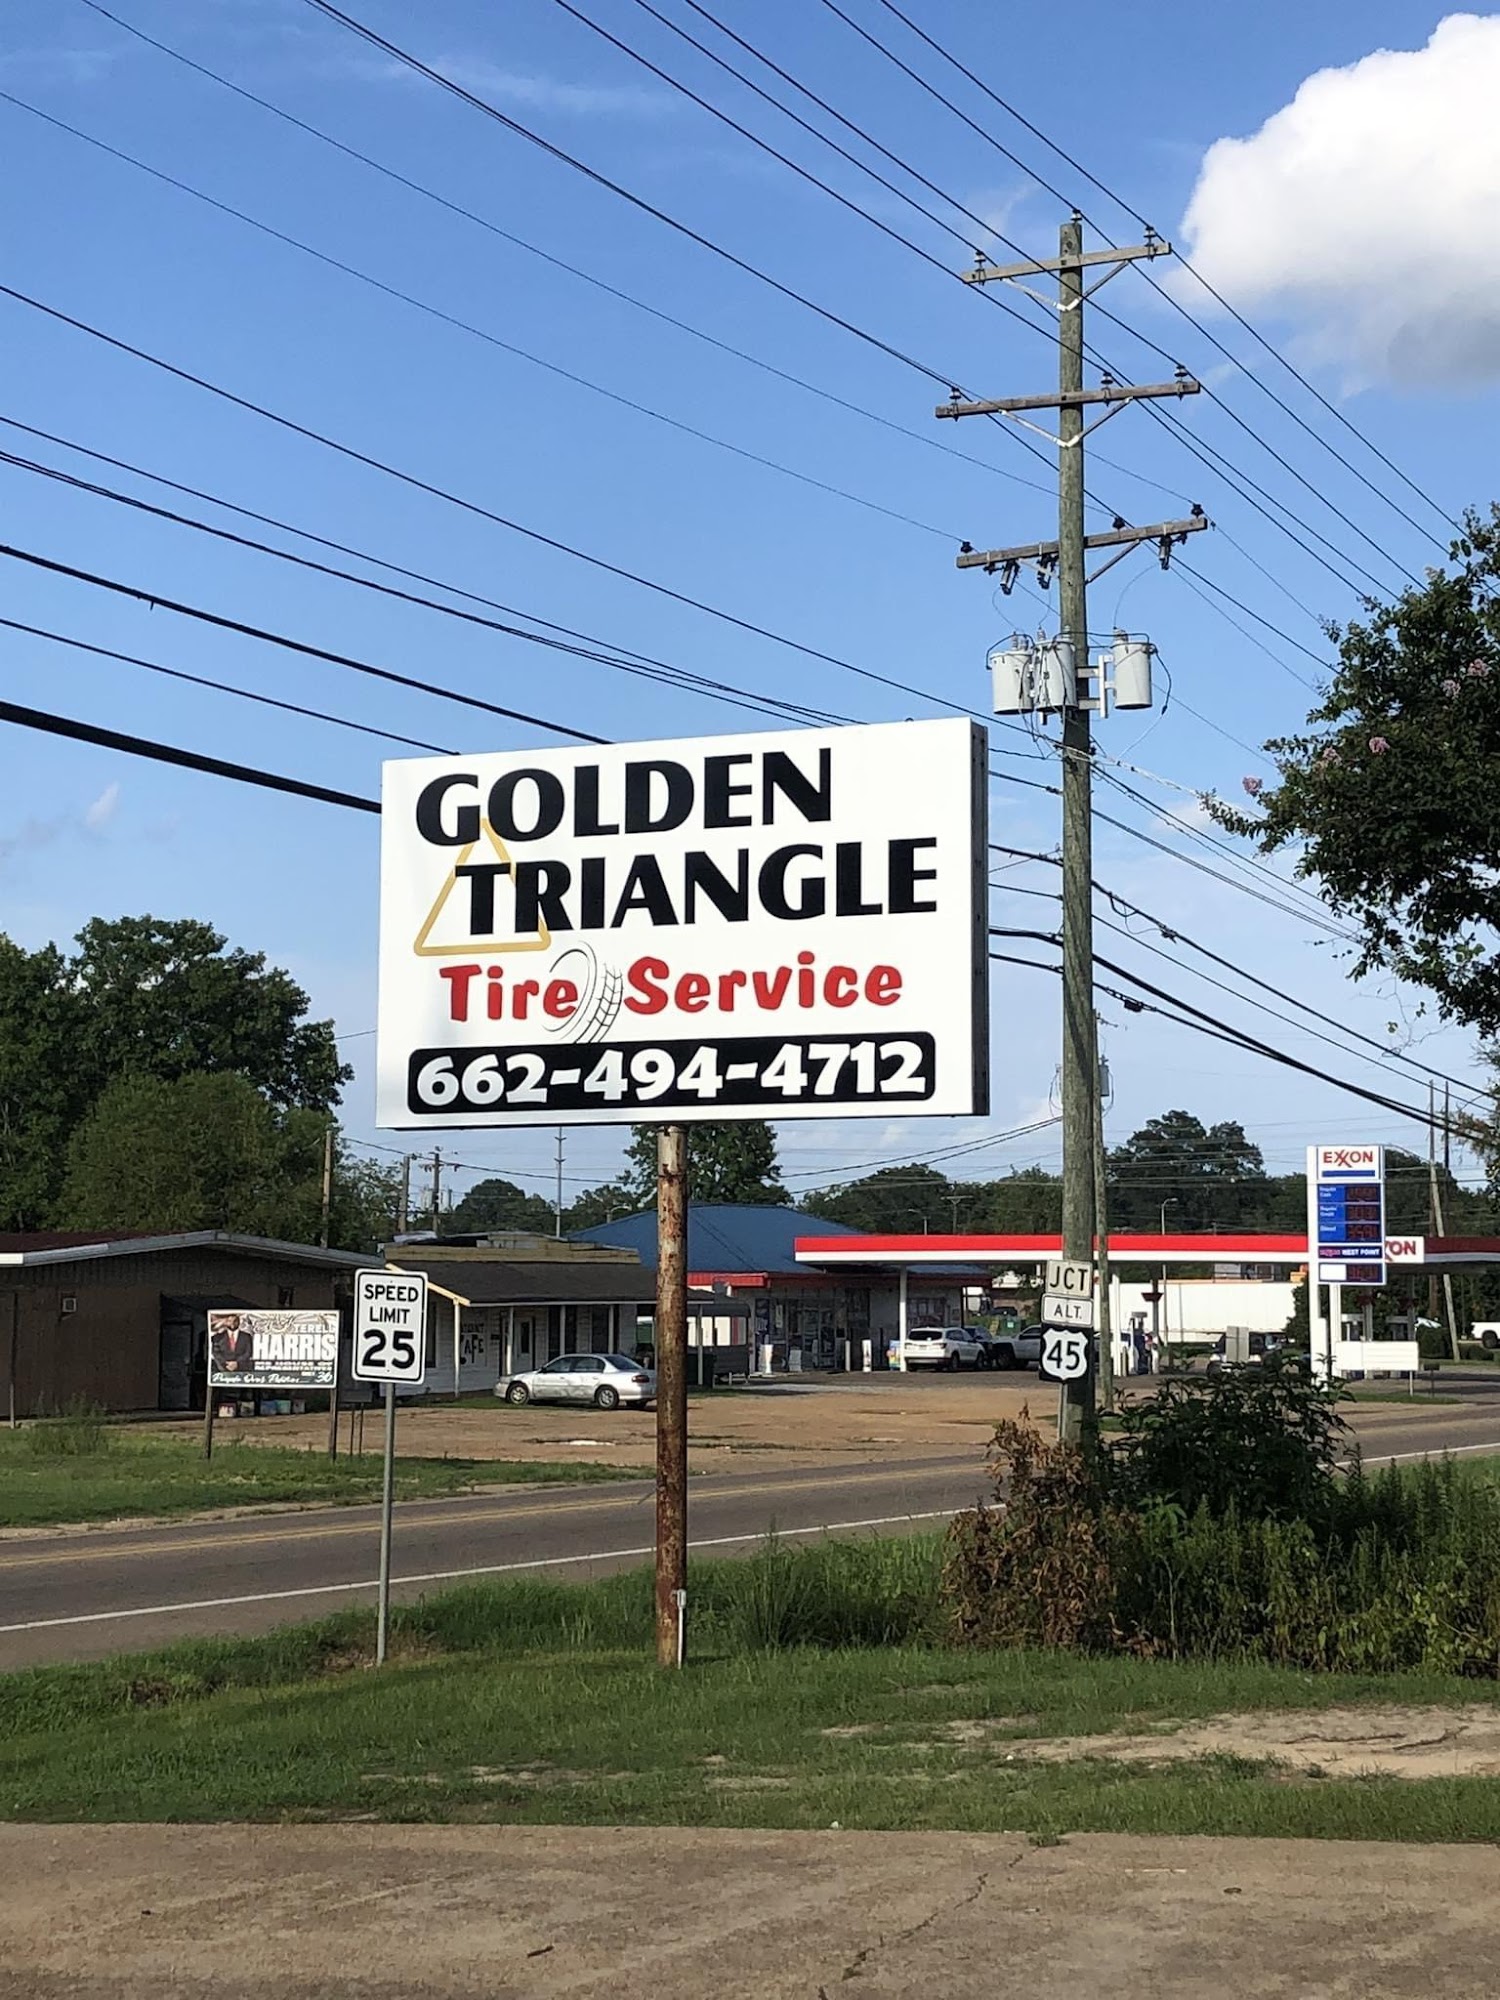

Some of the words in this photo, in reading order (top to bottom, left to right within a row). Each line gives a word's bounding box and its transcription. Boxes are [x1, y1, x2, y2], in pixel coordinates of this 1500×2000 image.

[415, 747, 832, 847] GOLDEN
[455, 837, 938, 936] TRIANGLE
[440, 964, 579, 1022] Tire
[623, 951, 903, 1015] Service
[415, 1041, 927, 1107] 662-494-4712
[1323, 1149, 1373, 1168] EXXON
[1342, 1248, 1359, 1256] WEST
[1360, 1248, 1380, 1256] POINT
[364, 1284, 419, 1302] SPEED
[1049, 1266, 1088, 1291] JCT
[369, 1306, 410, 1324] LIMIT
[252, 1333, 336, 1360] HARRIS
[362, 1329, 416, 1369] 25
[1047, 1339, 1080, 1370] 45
